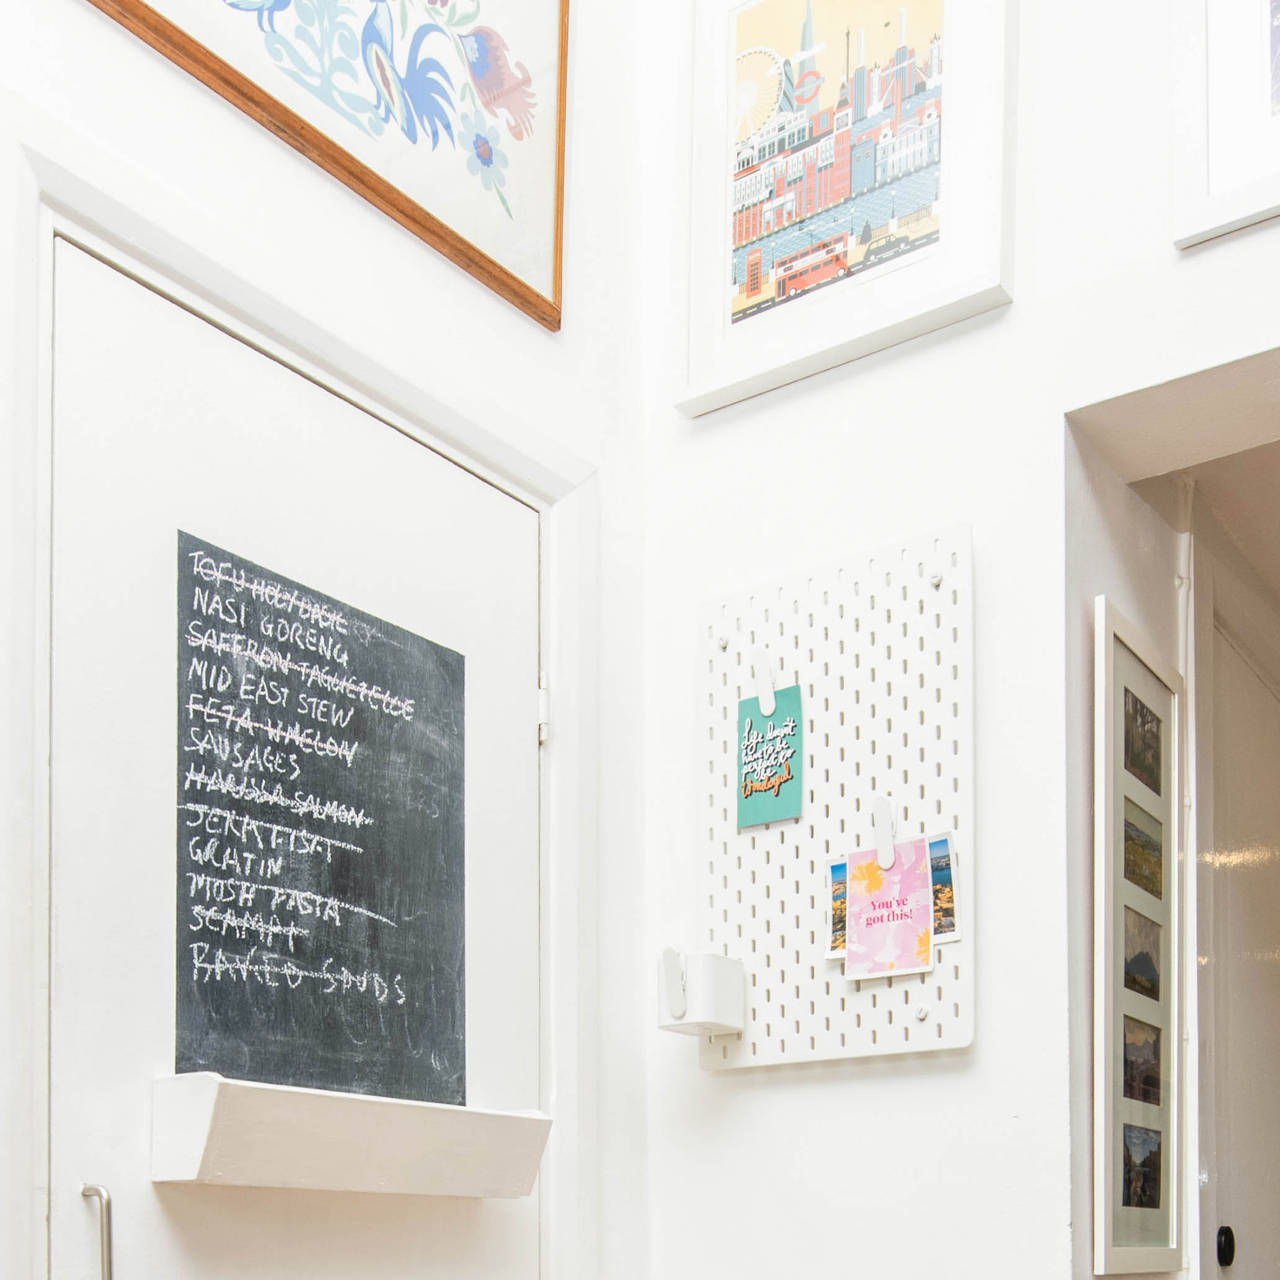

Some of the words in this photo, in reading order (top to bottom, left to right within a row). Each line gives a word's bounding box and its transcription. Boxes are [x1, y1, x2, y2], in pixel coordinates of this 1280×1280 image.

[188, 551, 246, 592] TOFU
[193, 586, 245, 628] NASI
[261, 615, 348, 668] GORENG
[187, 621, 291, 675] SAFFRON
[188, 657, 232, 692] MID
[240, 673, 289, 707] EAST
[298, 694, 355, 727] STEW
[188, 694, 255, 735] FETA
[184, 727, 300, 780] SAUSAGES
[741, 717, 765, 754] Life
[290, 791, 366, 828] SALMON
[189, 837, 283, 878] GRATIN
[270, 887, 342, 926] PASTA
[865, 915, 884, 928] got
[887, 908, 913, 921] this!
[870, 896, 908, 911] You've
[322, 957, 407, 1005] SPUDS
